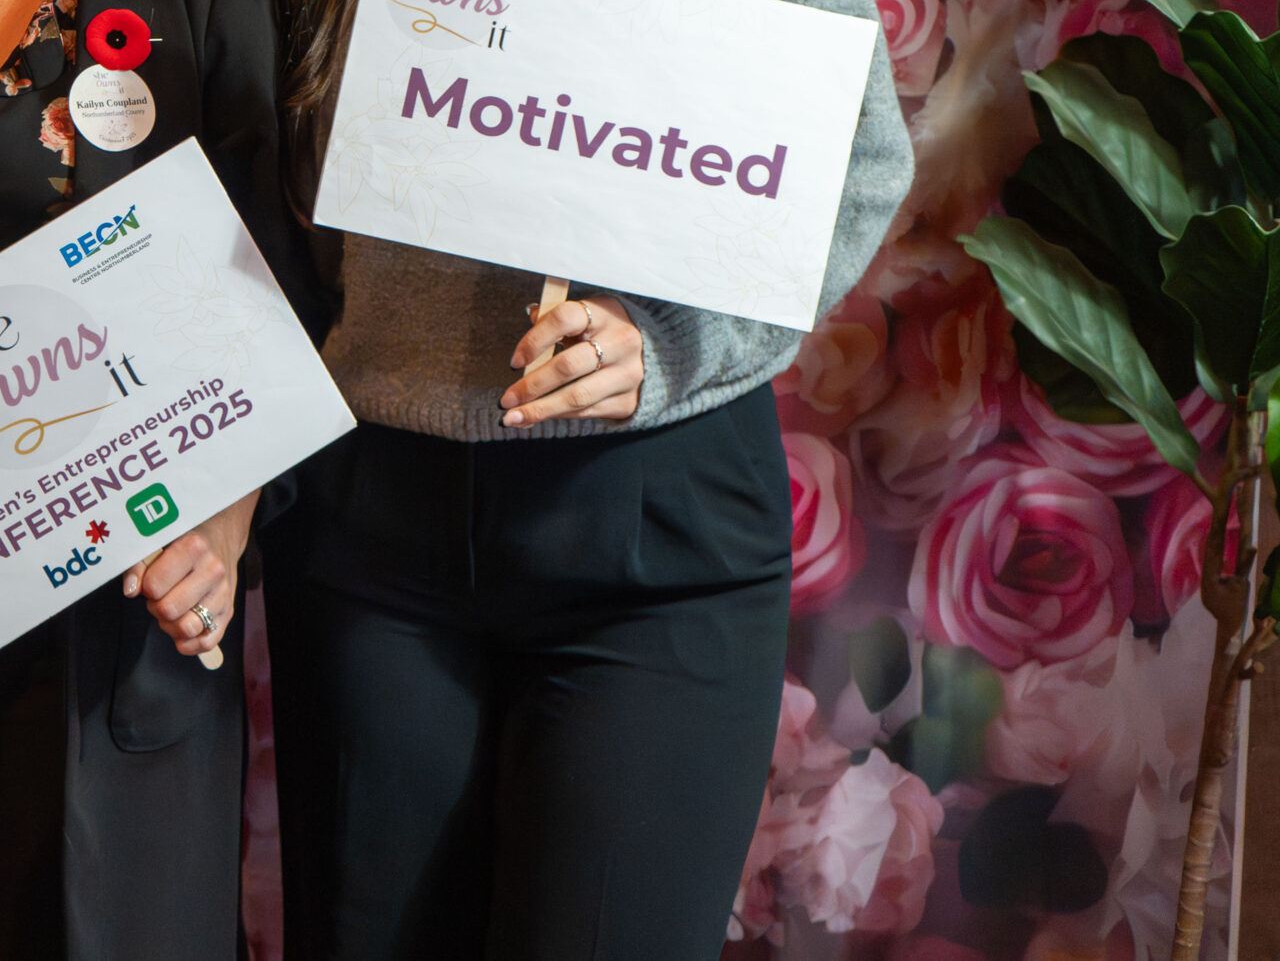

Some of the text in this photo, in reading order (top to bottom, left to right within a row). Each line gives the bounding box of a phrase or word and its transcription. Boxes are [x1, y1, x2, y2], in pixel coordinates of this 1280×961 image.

[487, 20, 511, 52] it
[76, 96, 148, 110] Kailyn Coupland
[400, 66, 789, 201] Motivated
[59, 206, 141, 268] BECN
[72, 266, 97, 283] BUSINESS
[101, 233, 152, 266] ENTREPRENEURSHIP
[80, 241, 150, 285] CENTRE NORTHUMBERLAND
[104, 353, 148, 397] it
[37, 377, 224, 495] Entrepreneurship
[168, 389, 253, 454] 2025
[43, 546, 102, 588] bdc
